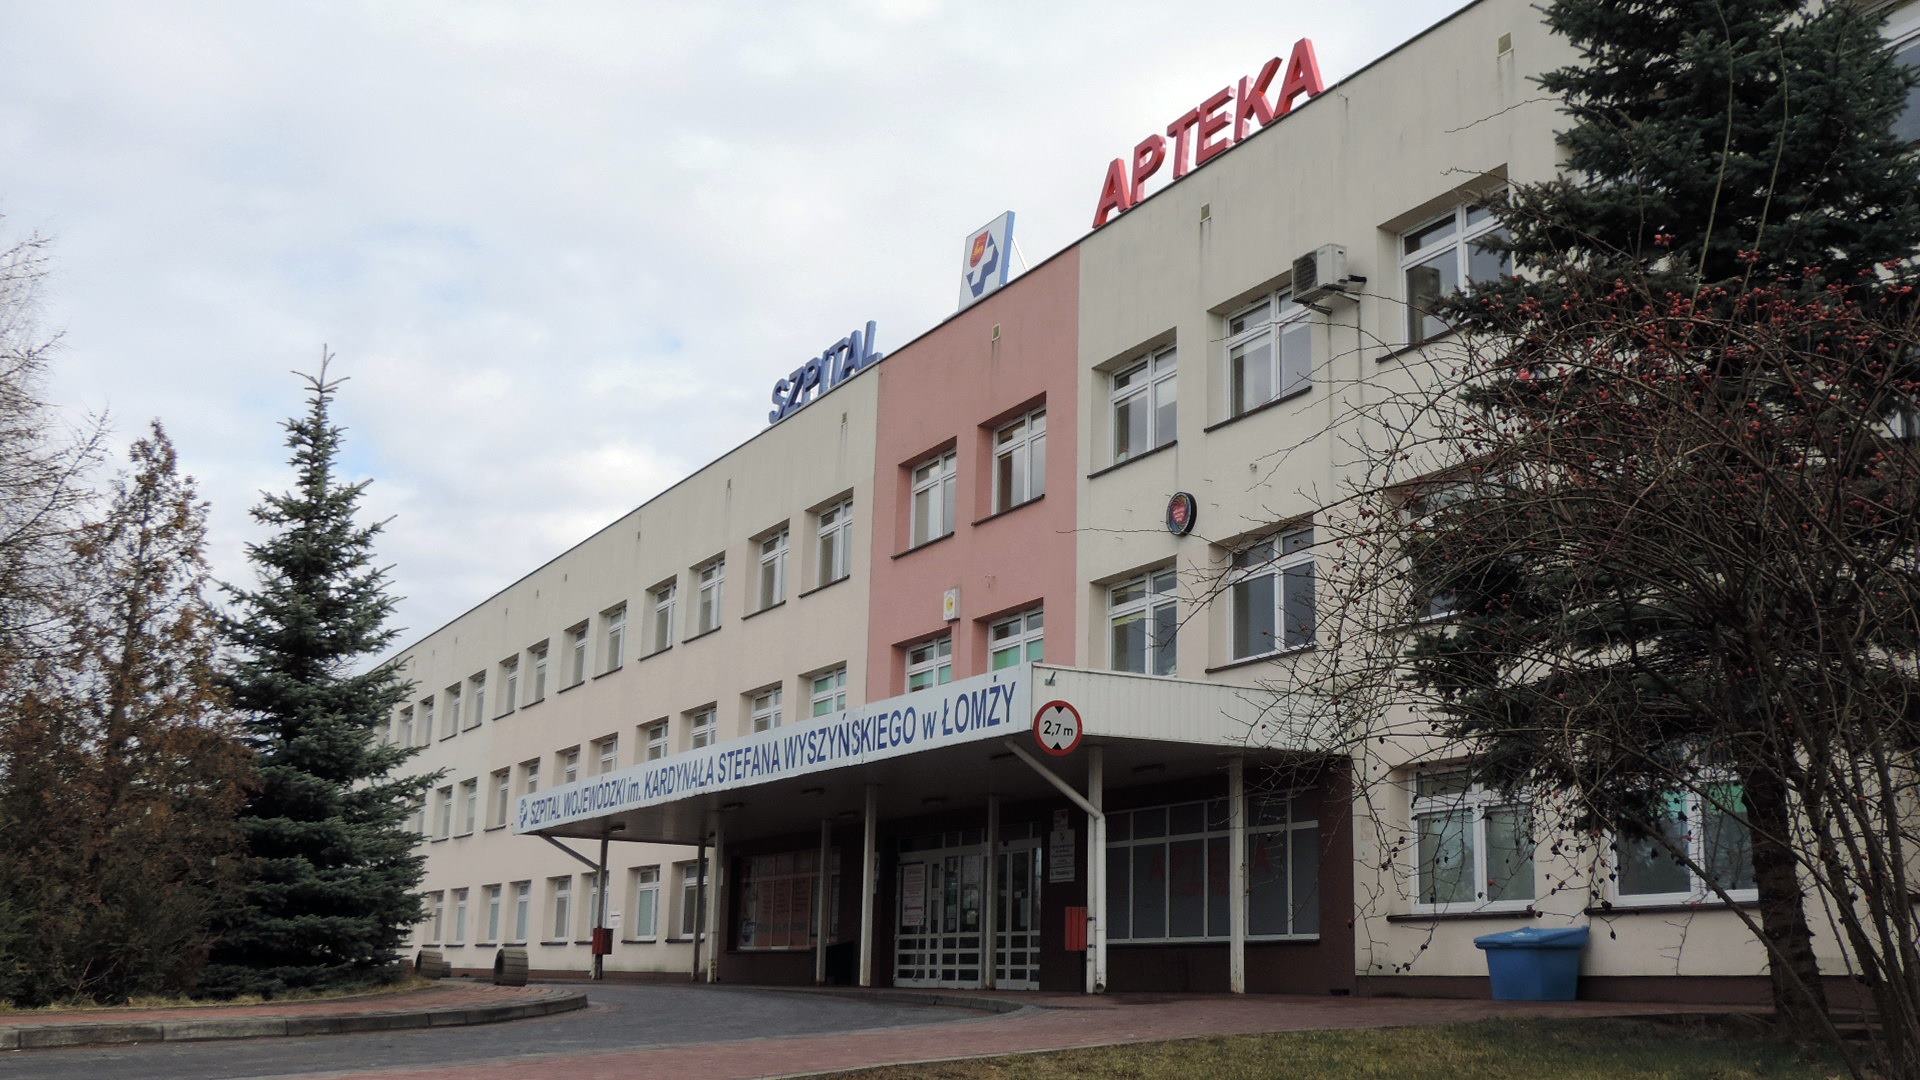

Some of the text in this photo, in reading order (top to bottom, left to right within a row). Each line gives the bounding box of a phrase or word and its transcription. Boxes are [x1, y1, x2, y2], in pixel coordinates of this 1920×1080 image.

[1092, 37, 1324, 229] APTEKA
[768, 319, 883, 424] SZPITAL
[530, 675, 1017, 825] SZPITAL WOJEWÓDZKI im. KARDYNAŁA STEFANA WYSZYŃSKIEGO w ŁOMŻY
[1043, 720, 1074, 736] 2,7 m
